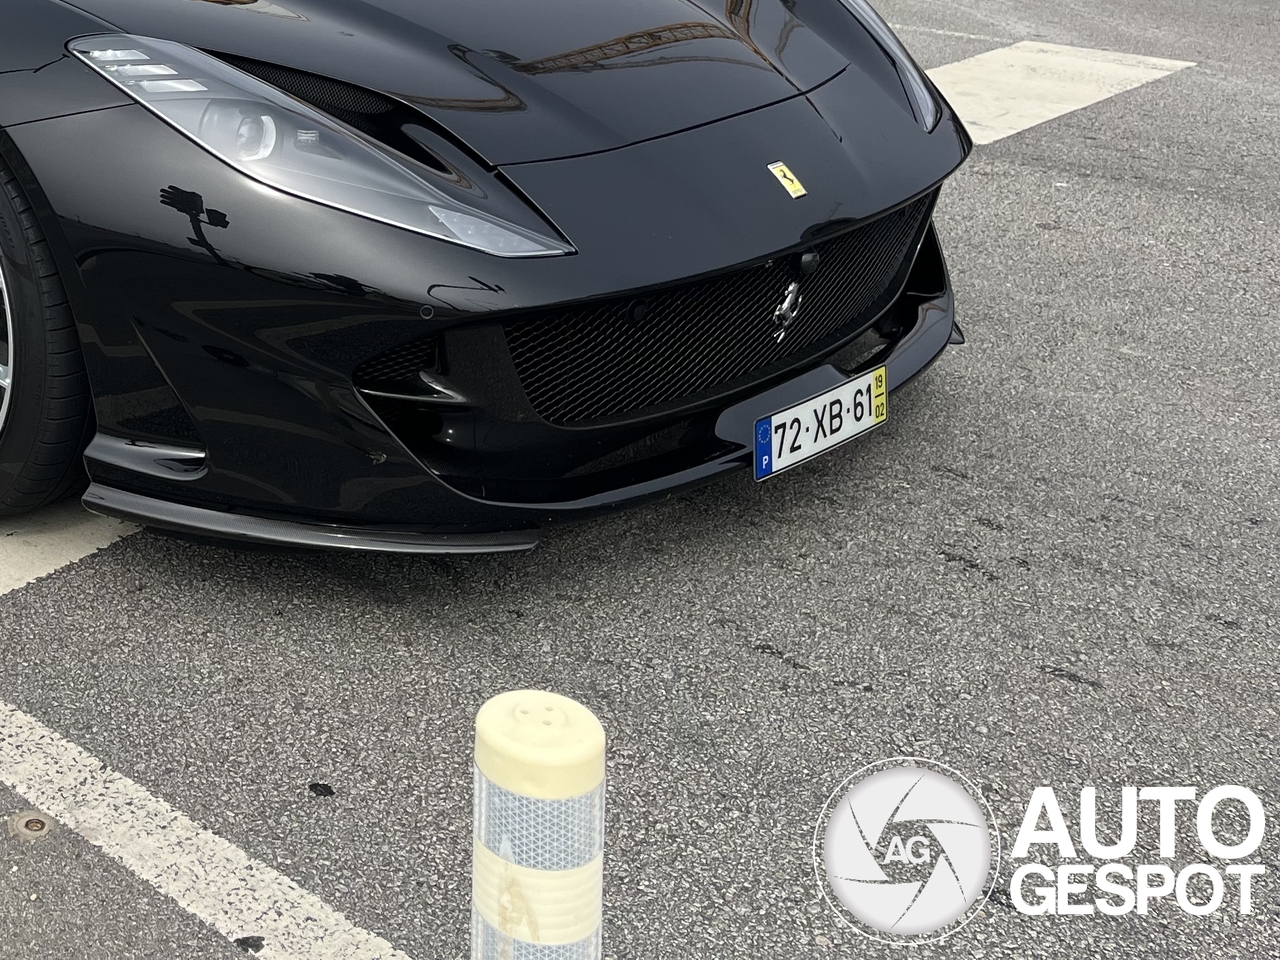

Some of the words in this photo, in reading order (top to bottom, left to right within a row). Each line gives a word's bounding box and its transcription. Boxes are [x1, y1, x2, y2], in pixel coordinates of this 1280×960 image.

[875, 374, 883, 390] 19
[875, 402, 885, 419] 02
[762, 455, 769, 469] P
